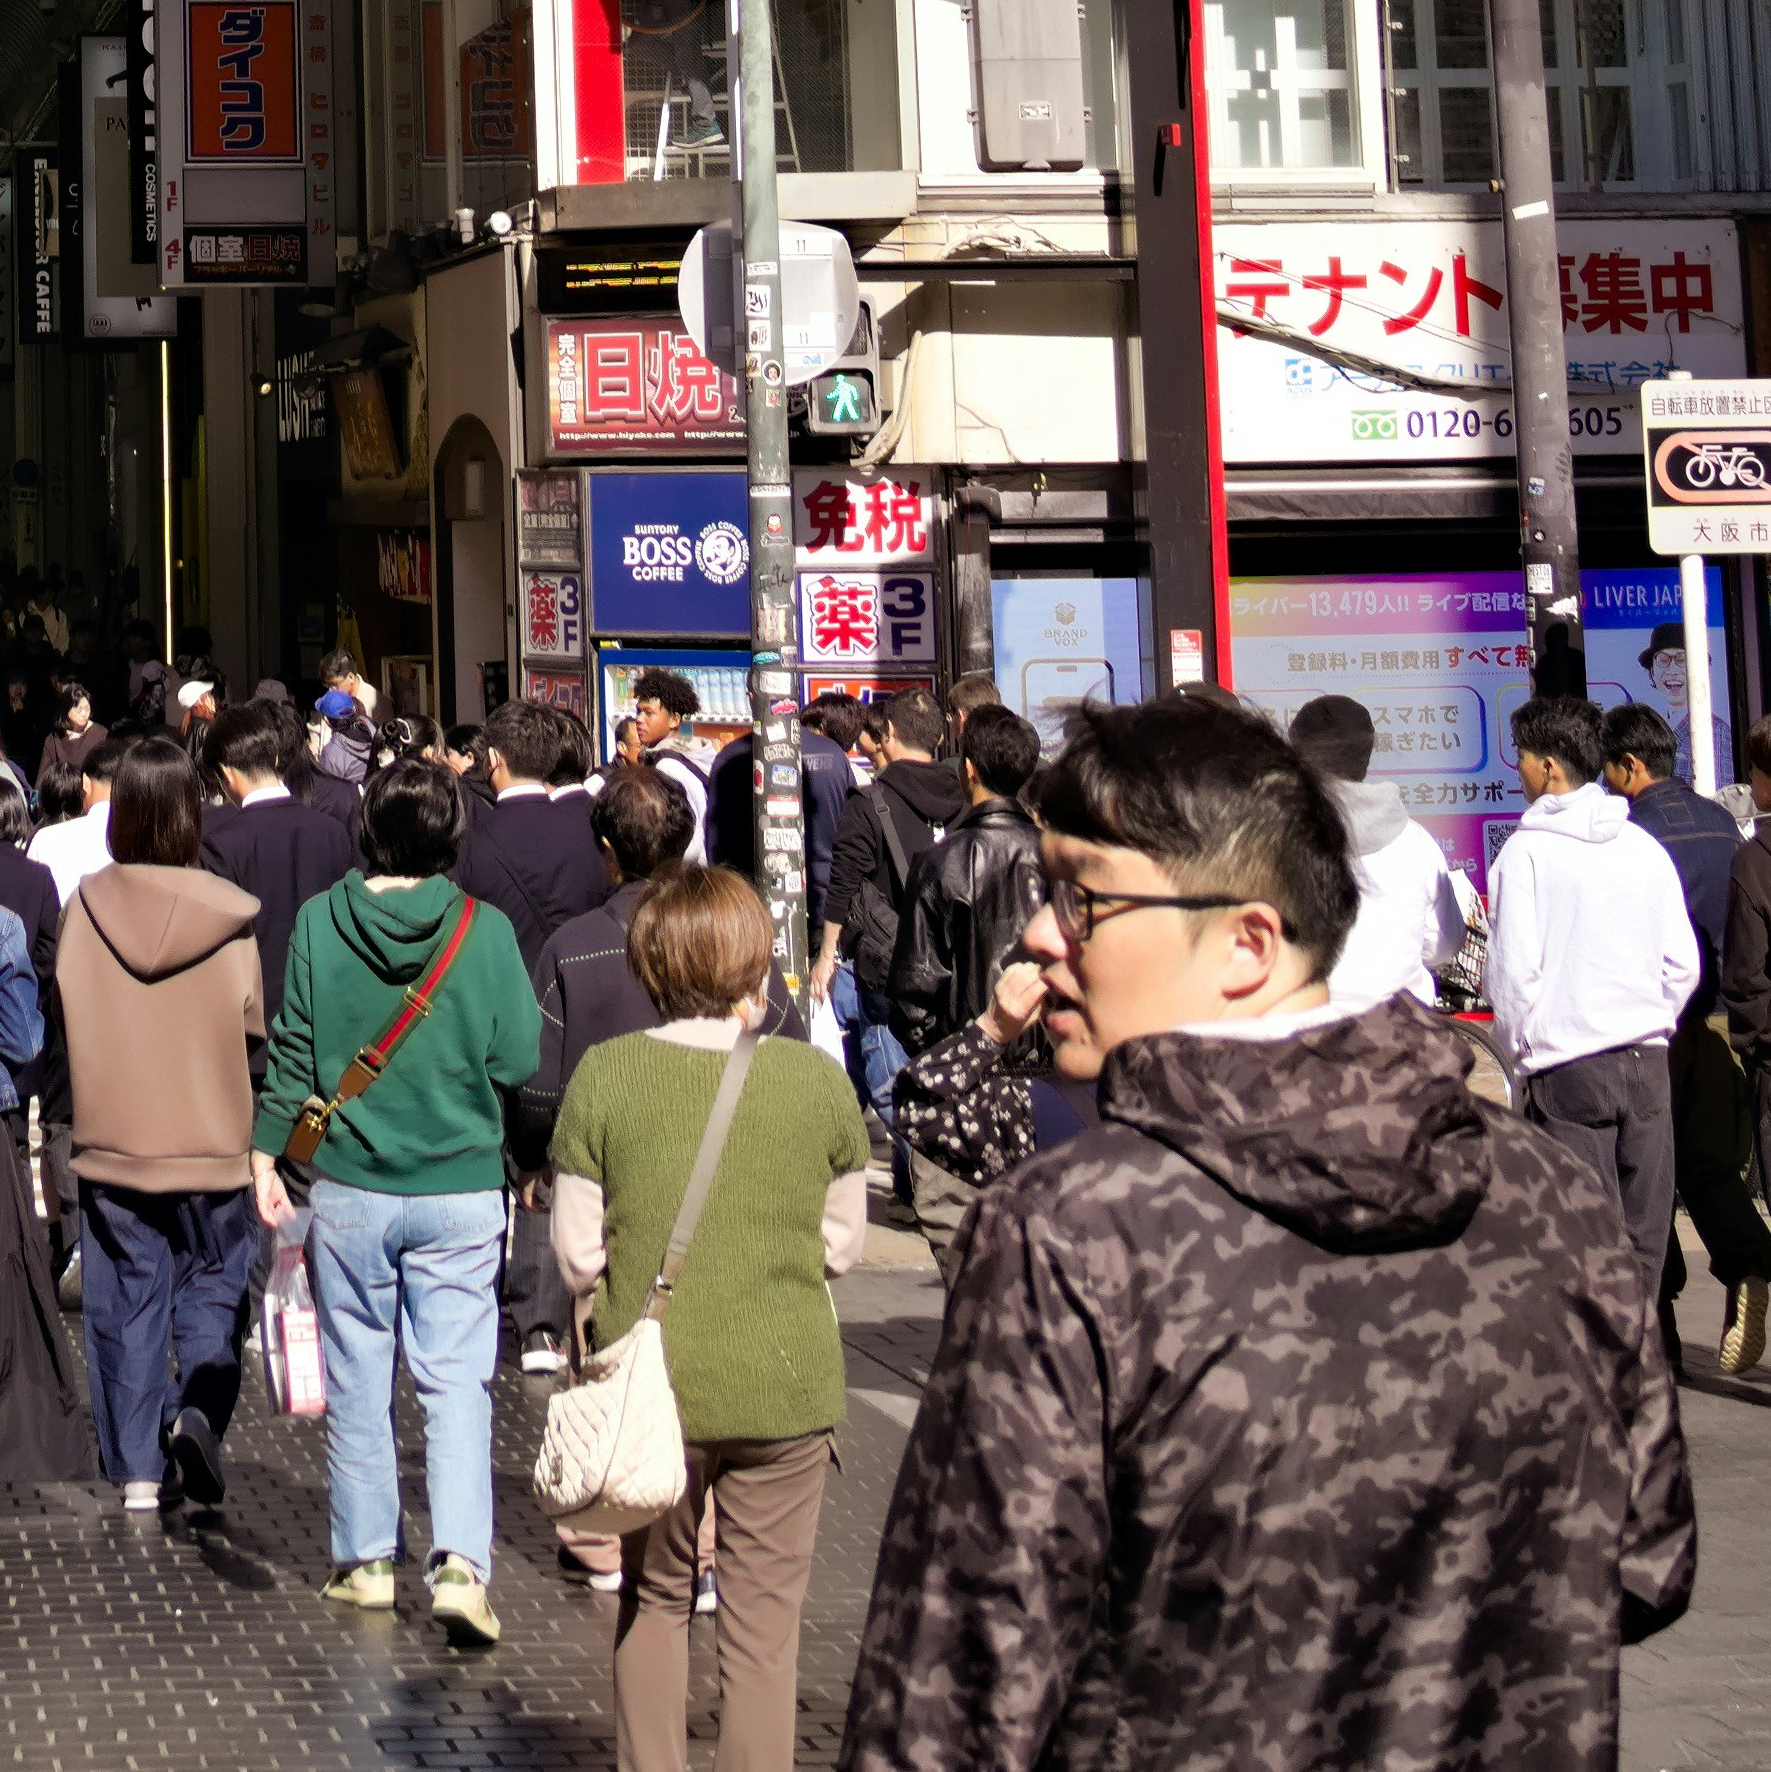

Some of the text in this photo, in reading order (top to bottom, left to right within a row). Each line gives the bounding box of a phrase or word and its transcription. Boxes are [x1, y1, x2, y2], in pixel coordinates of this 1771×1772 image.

[216, 7, 267, 152] ダイコク
[144, 161, 157, 243] COSMETICS
[35, 269, 52, 335] CAFFE
[557, 333, 578, 426] 完全個室
[634, 523, 680, 535] SUNTORY
[802, 479, 928, 554] 免税
[1692, 522, 1770, 544] 大阪市
[622, 535, 693, 567] BOSS
[631, 565, 684, 582] COFFEE
[1594, 582, 1683, 608] LIVER JAP
[528, 571, 560, 652] 薬
[806, 574, 927, 657] 薬 3F
[1043, 628, 1088, 639] BRAND
[1053, 637, 1079, 647] VOX
[1372, 704, 1461, 726] スマホで
